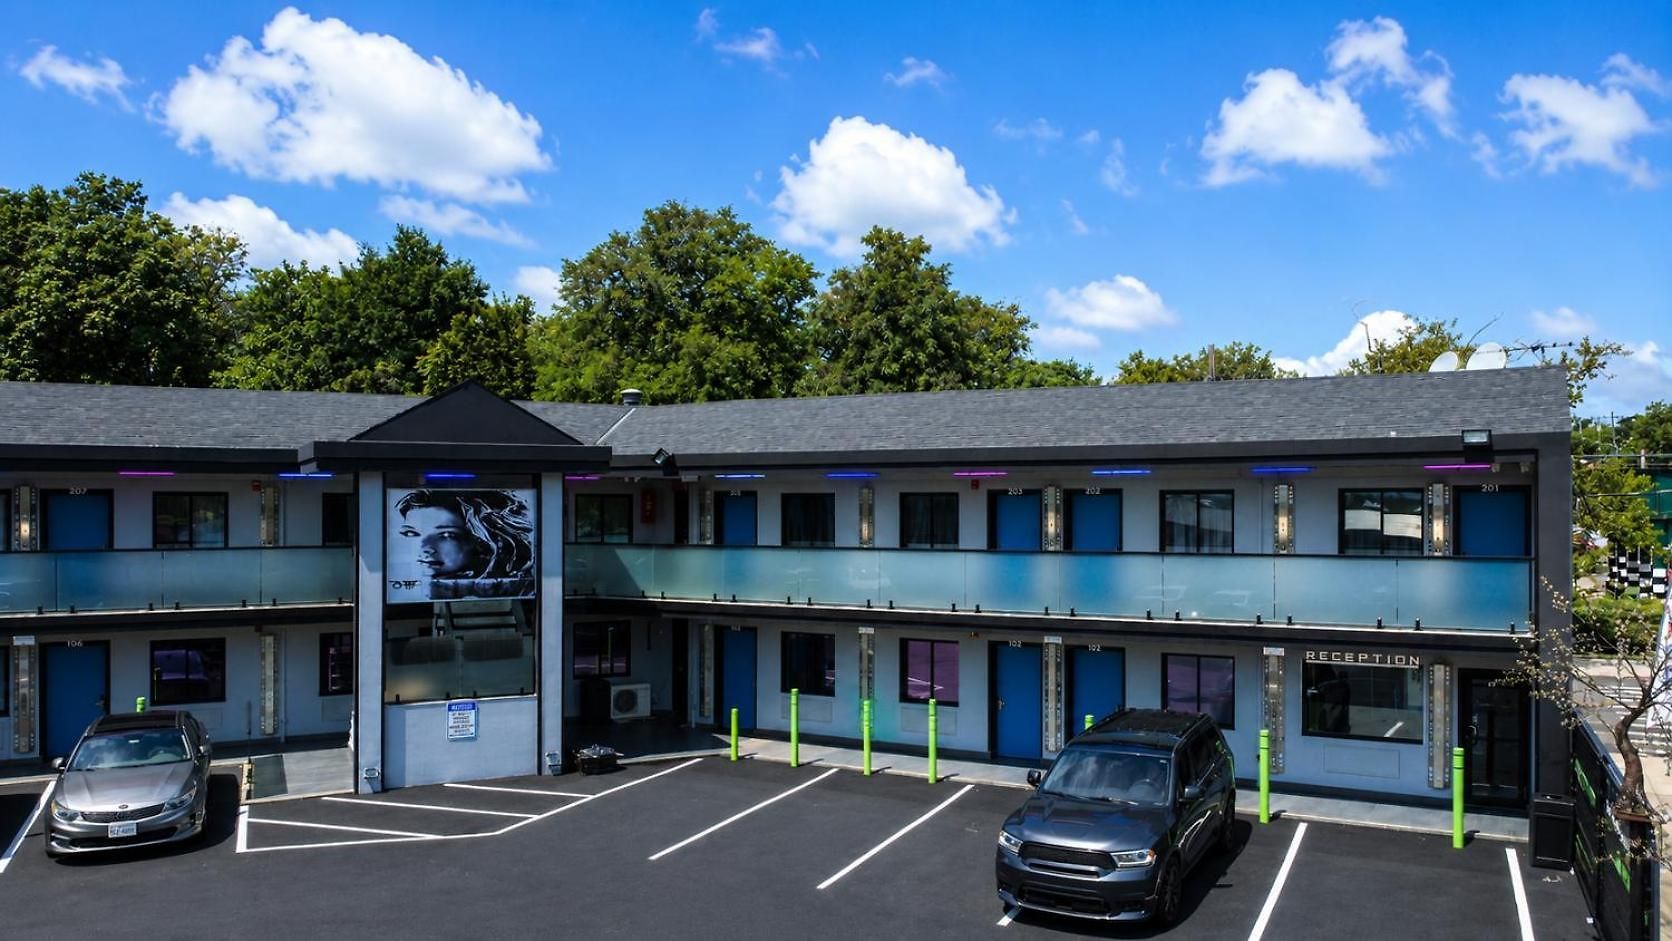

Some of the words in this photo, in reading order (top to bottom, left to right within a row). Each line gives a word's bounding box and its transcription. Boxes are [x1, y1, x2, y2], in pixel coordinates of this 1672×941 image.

[69, 487, 87, 495] 207
[1007, 488, 1023, 496] 203
[1481, 484, 1499, 493] 201
[67, 640, 83, 648] 106
[1008, 640, 1022, 648] 102
[1305, 651, 1420, 665] RECEPTION
